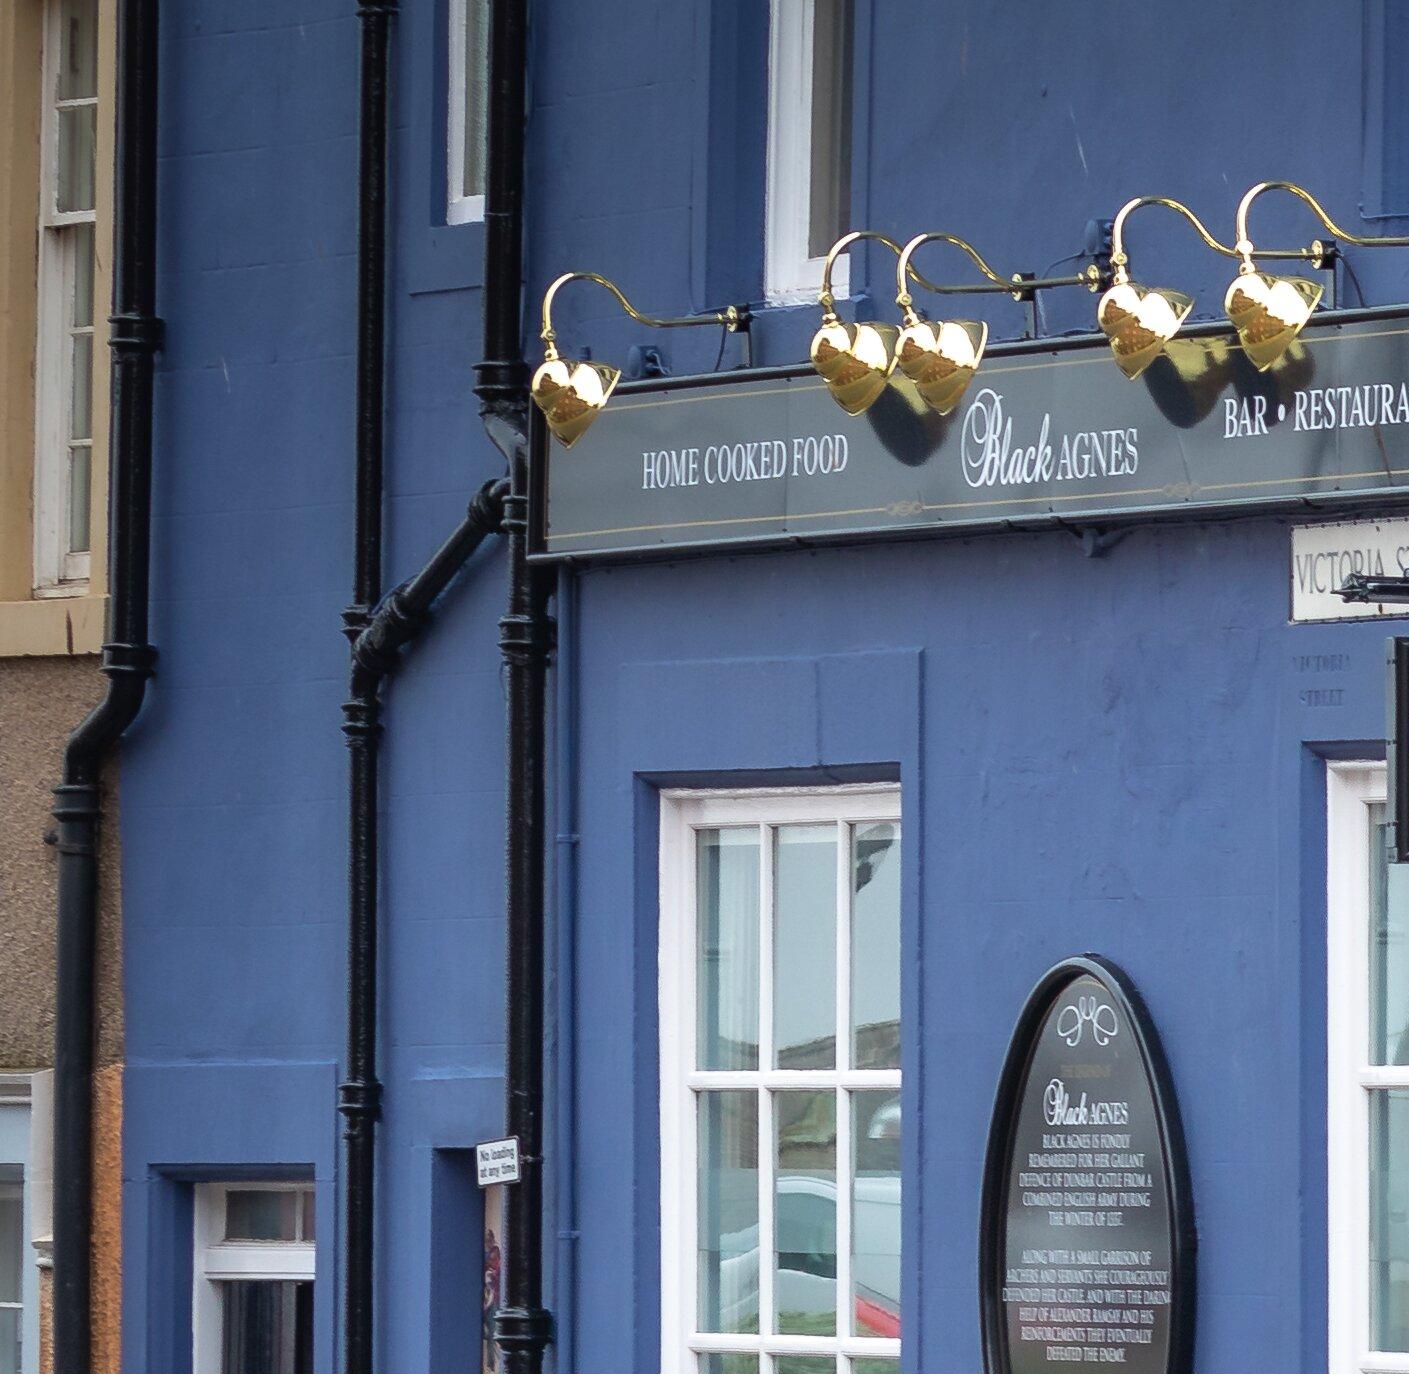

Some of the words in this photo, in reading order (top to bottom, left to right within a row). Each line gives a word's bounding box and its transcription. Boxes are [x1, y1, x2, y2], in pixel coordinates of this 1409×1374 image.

[960, 388, 1053, 488] Black
[1055, 427, 1138, 481] AGNES
[1223, 395, 1269, 439] BAR
[641, 448, 699, 490] HOME
[704, 440, 787, 484] COOKED
[791, 434, 849, 477] FOOD
[1296, 548, 1385, 594] VICTORIA
[1089, 1102, 1128, 1125] AGNES
[480, 1149, 490, 1162] No
[491, 1146, 515, 1160] loading
[488, 1167, 500, 1178] any
[501, 1163, 516, 1175] time
